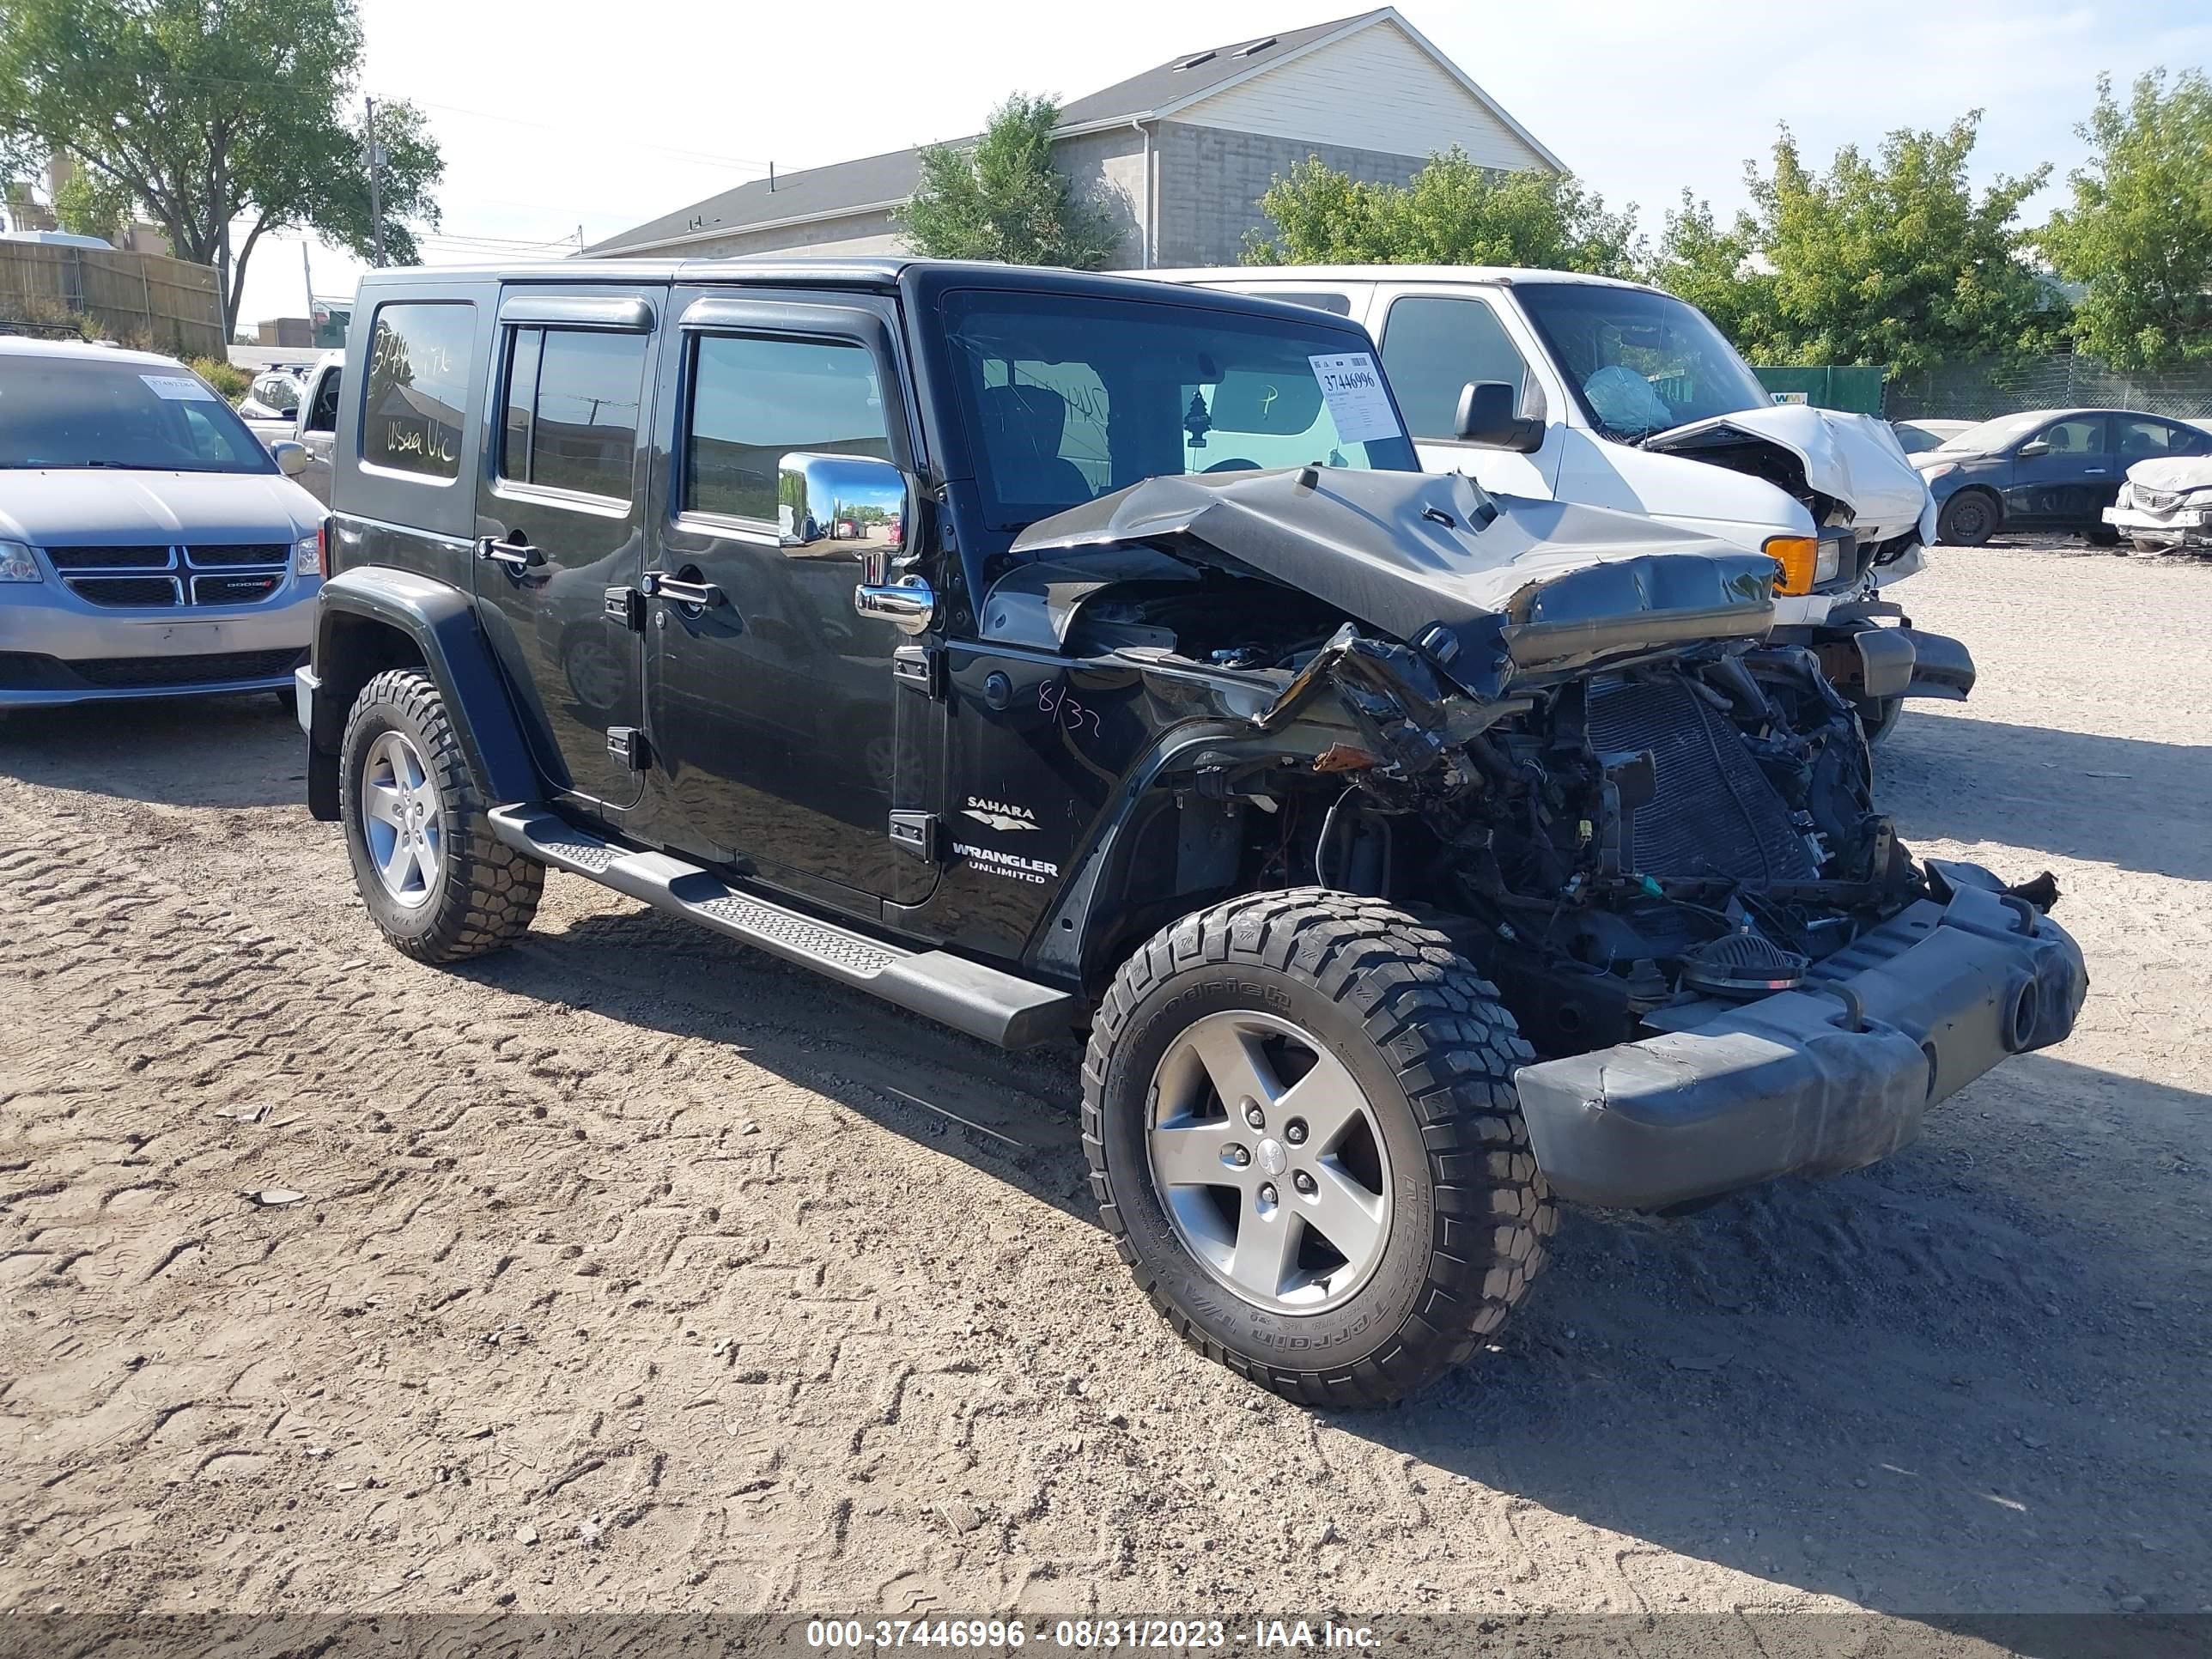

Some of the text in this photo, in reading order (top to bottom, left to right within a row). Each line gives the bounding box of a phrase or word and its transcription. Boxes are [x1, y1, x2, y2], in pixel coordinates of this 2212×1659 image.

[1324, 372, 1376, 392] 37446996
[967, 796, 1036, 820] SAHARA
[952, 842, 1059, 878] WRANGLER
[969, 860, 1045, 884] UNLIMITED
